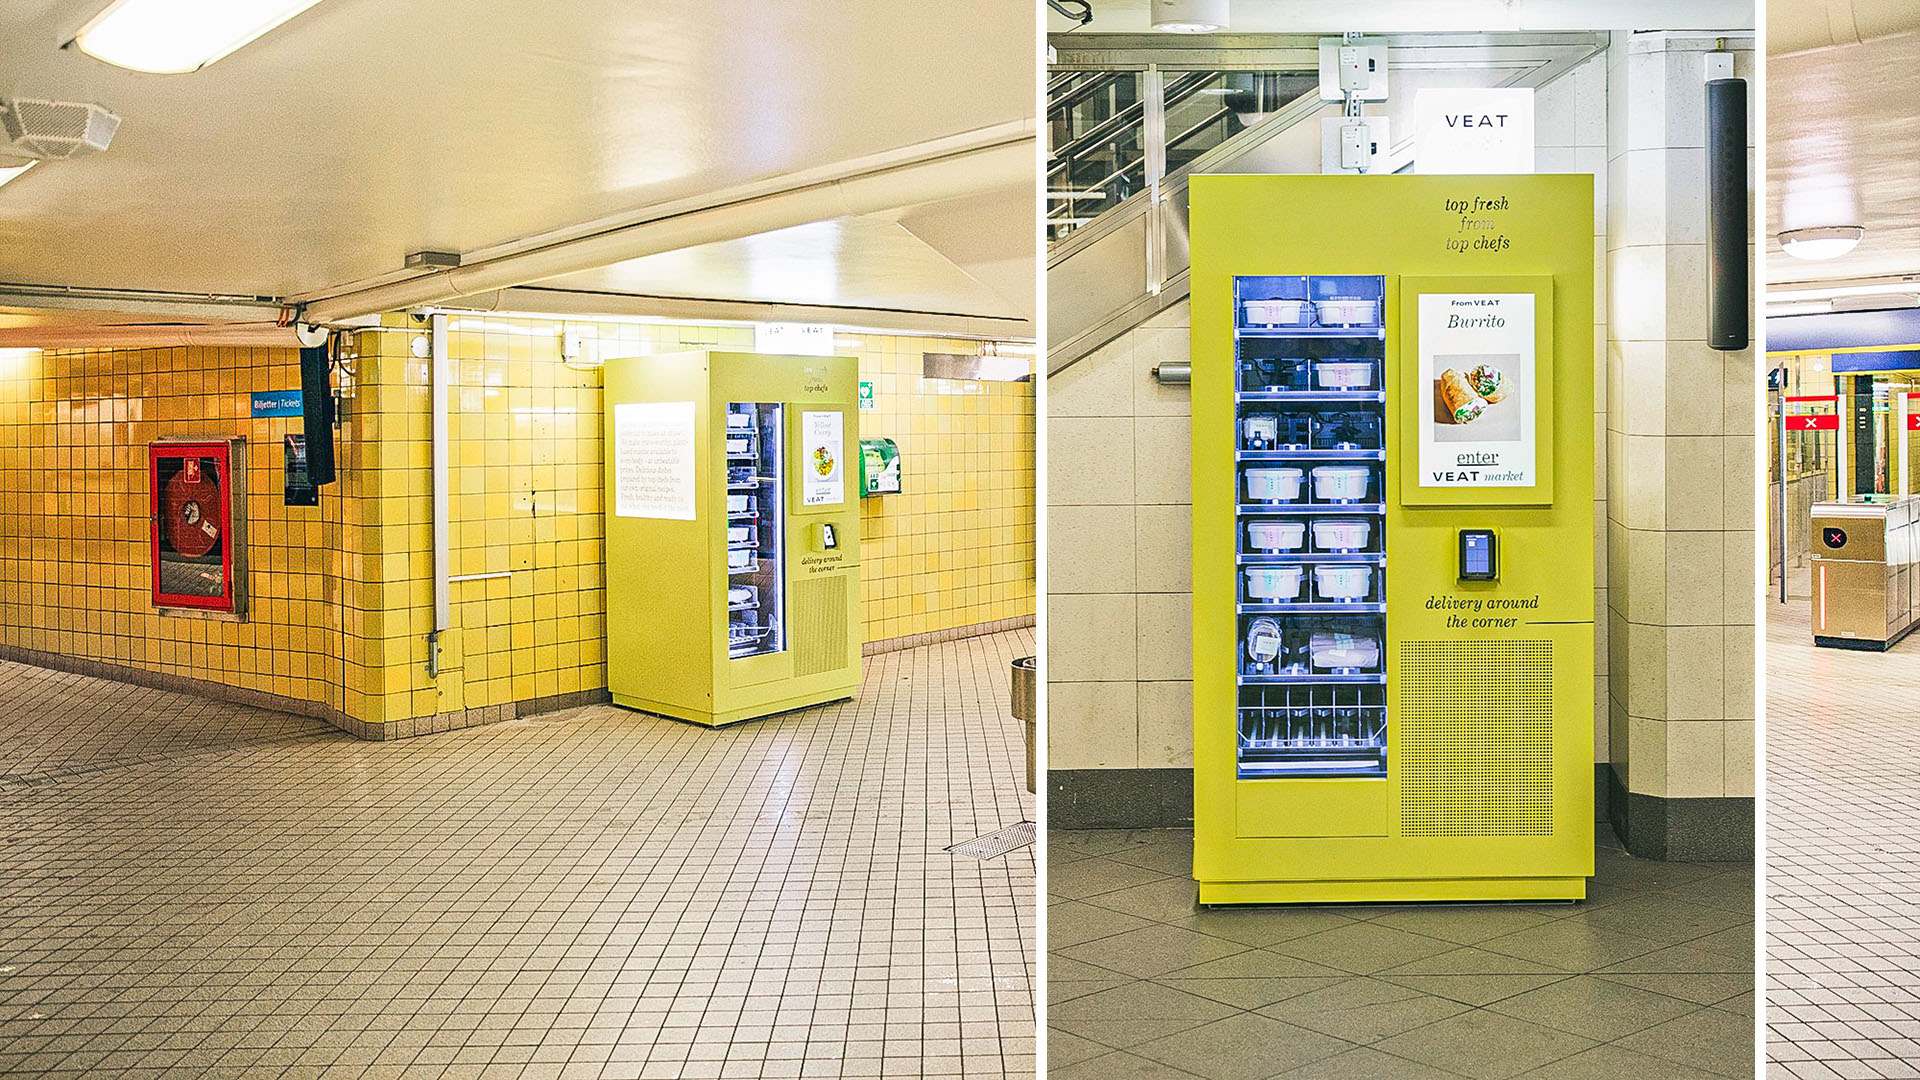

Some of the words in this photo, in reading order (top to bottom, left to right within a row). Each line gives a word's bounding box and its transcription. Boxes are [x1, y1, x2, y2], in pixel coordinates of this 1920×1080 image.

[1445, 115, 1508, 128] VEAT
[1445, 198, 1469, 214] top
[1471, 196, 1510, 214] fresh
[1458, 216, 1495, 233] from
[1446, 237, 1469, 253] top
[1473, 234, 1510, 252] chefs
[1447, 314, 1505, 329] Burrito
[281, 399, 300, 408] Tickets
[1457, 451, 1499, 465] enter
[1433, 471, 1480, 481] VEAT
[1484, 470, 1523, 481] market
[801, 556, 822, 565] delivery
[823, 553, 843, 563] around
[1425, 595, 1483, 612] delivery
[1486, 595, 1539, 609] around
[1447, 615, 1469, 628] the
[1472, 616, 1518, 628] corner
